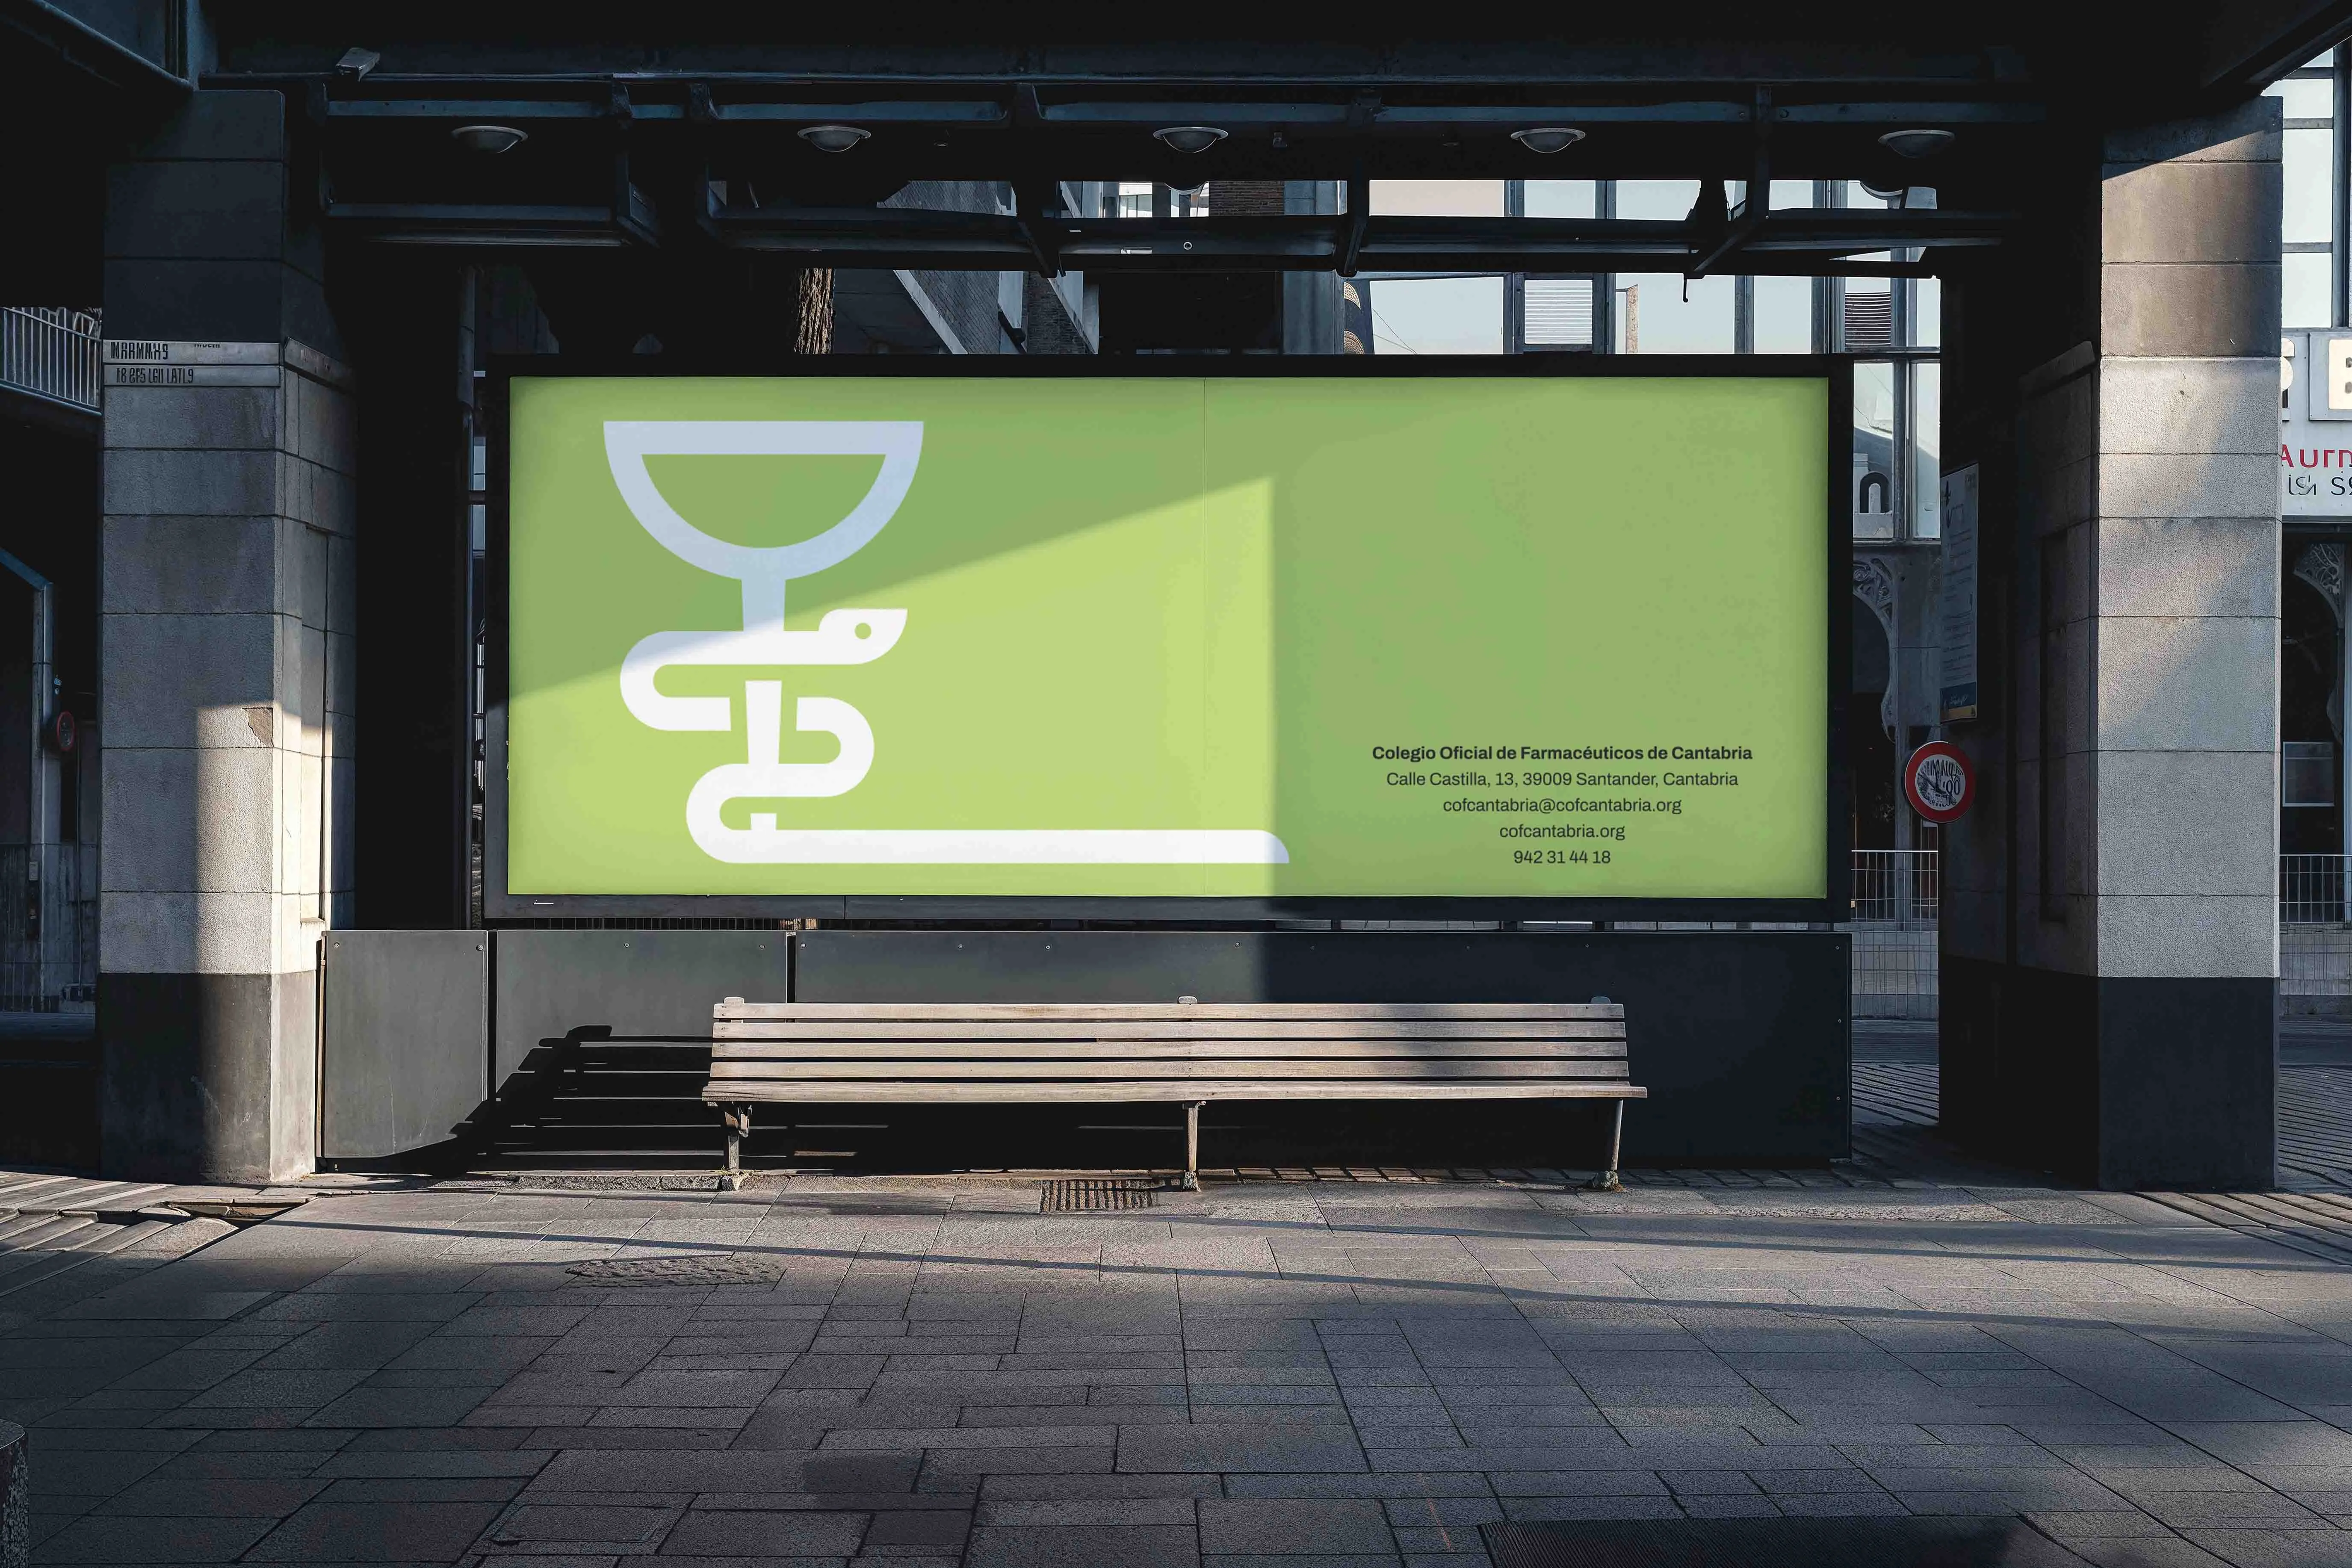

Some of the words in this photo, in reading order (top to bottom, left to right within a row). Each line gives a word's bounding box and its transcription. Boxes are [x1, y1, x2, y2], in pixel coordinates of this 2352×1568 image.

[1372, 746, 1436, 762] Colegio
[1439, 746, 1492, 759] Oficial
[1496, 746, 1516, 759] de
[1521, 746, 1644, 759] Farmacéuticos
[1648, 746, 1668, 759] de
[1672, 746, 1753, 759] Cantabria
[1387, 772, 1425, 785] Calle
[1430, 772, 1490, 787] Castilla,
[1495, 772, 1518, 787] 13,
[1523, 772, 1572, 785] 39009
[1576, 772, 1658, 787] Santander,
[1664, 772, 1738, 785] Cantabria
[1443, 798, 1682, 815] cofcantabria@cofcantabria.org
[1500, 824, 1625, 841] cofcantabria.org
[1514, 850, 1542, 864] 942
[1547, 850, 1566, 864] 31
[1569, 850, 1588, 864] 44
[1593, 850, 1610, 864] 18
